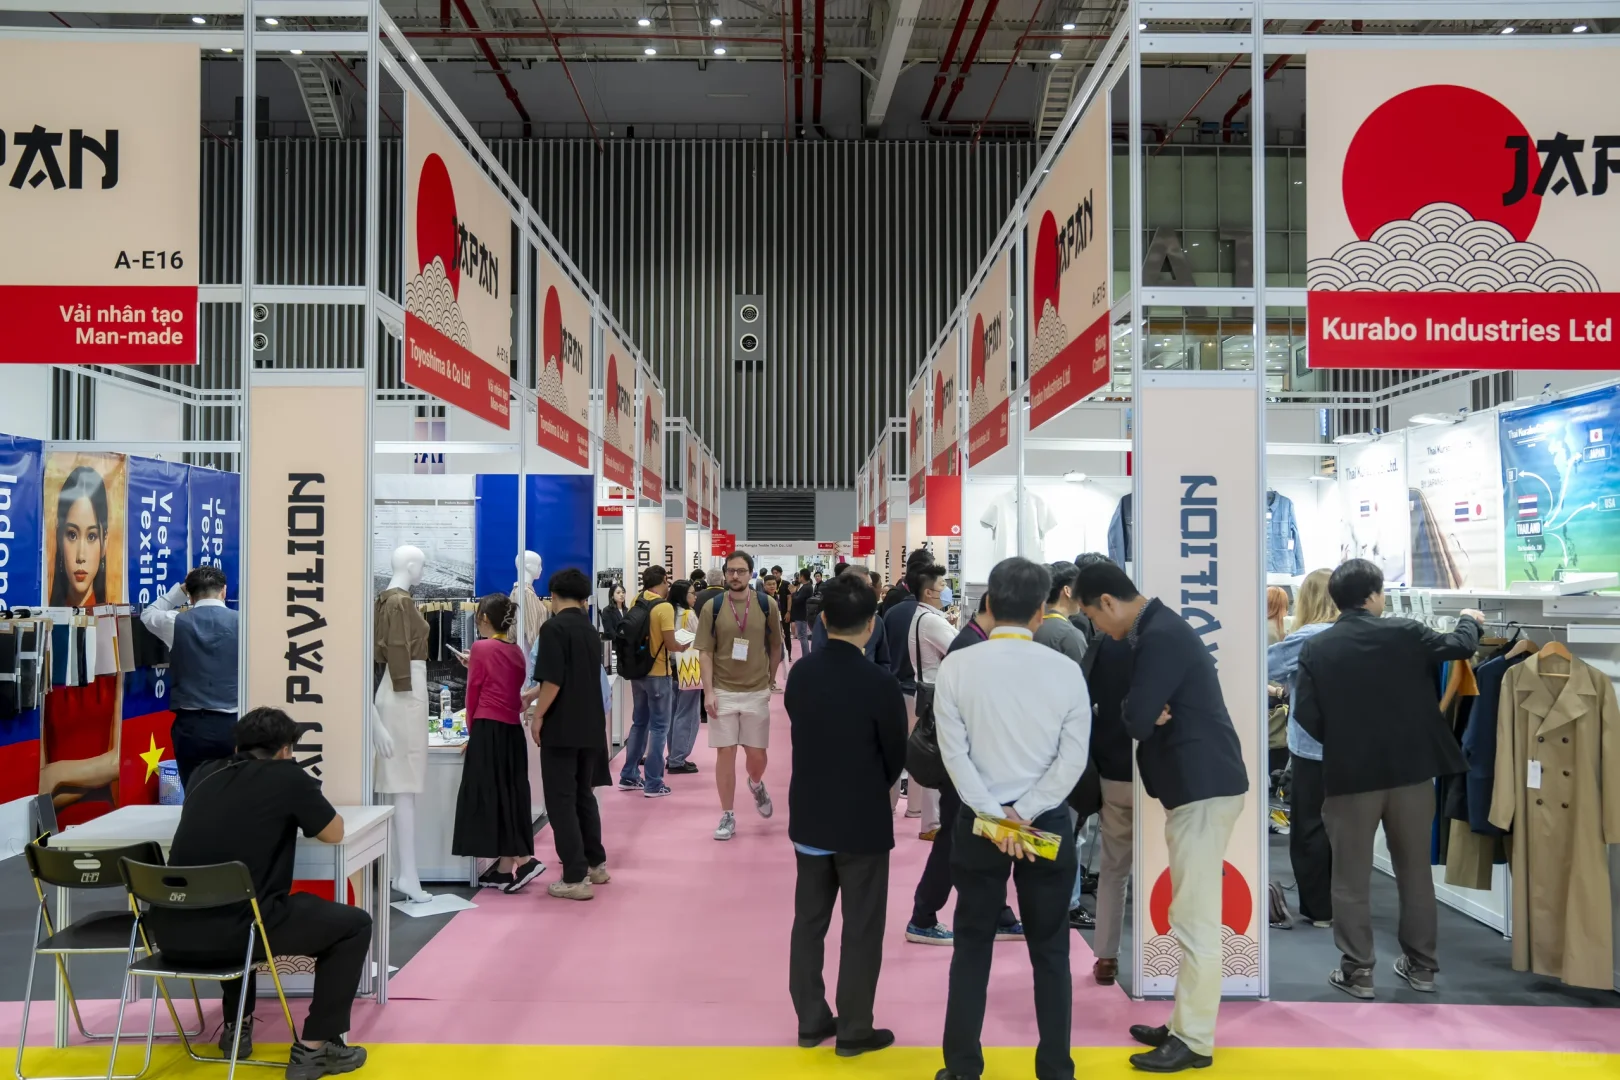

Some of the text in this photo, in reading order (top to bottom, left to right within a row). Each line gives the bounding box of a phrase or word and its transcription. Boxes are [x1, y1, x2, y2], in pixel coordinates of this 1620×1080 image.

[452, 215, 499, 300] JAPAN
[1054, 188, 1094, 291] JAPAN
[114, 250, 184, 269] A-E16
[1092, 281, 1106, 308] A-E15
[59, 303, 183, 326] Vải nhân tạo
[1322, 316, 1612, 342] Kurabo Industries Ltd
[75, 327, 183, 345] Man-made
[559, 323, 583, 375] JAPAN
[983, 311, 1001, 371] JAPAN
[410, 337, 471, 390] Toyoshima & Co Ltd
[1516, 522, 1541, 536] THAILAND
[284, 472, 328, 704] PAVILION
